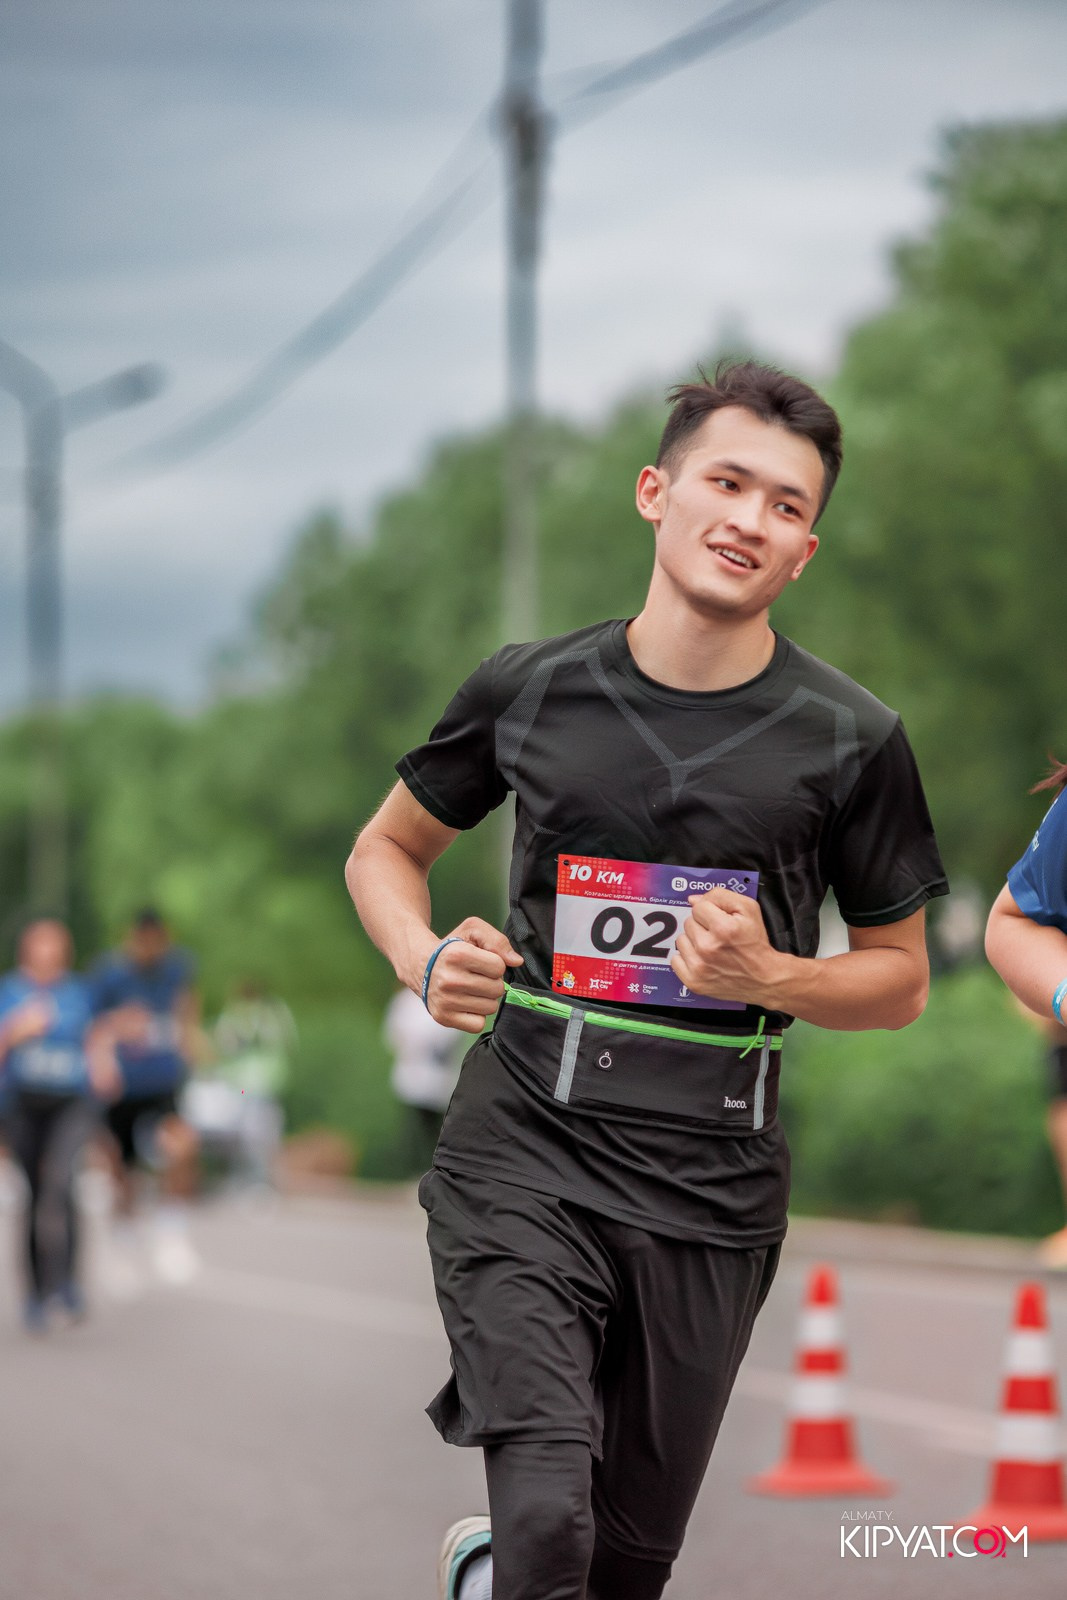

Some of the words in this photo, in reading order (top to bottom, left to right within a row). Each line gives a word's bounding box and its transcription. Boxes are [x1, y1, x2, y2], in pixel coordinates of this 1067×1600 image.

[569, 864, 592, 882] 10
[596, 871, 624, 885] KM
[590, 906, 678, 958] 02
[723, 1096, 747, 1109] hoco.
